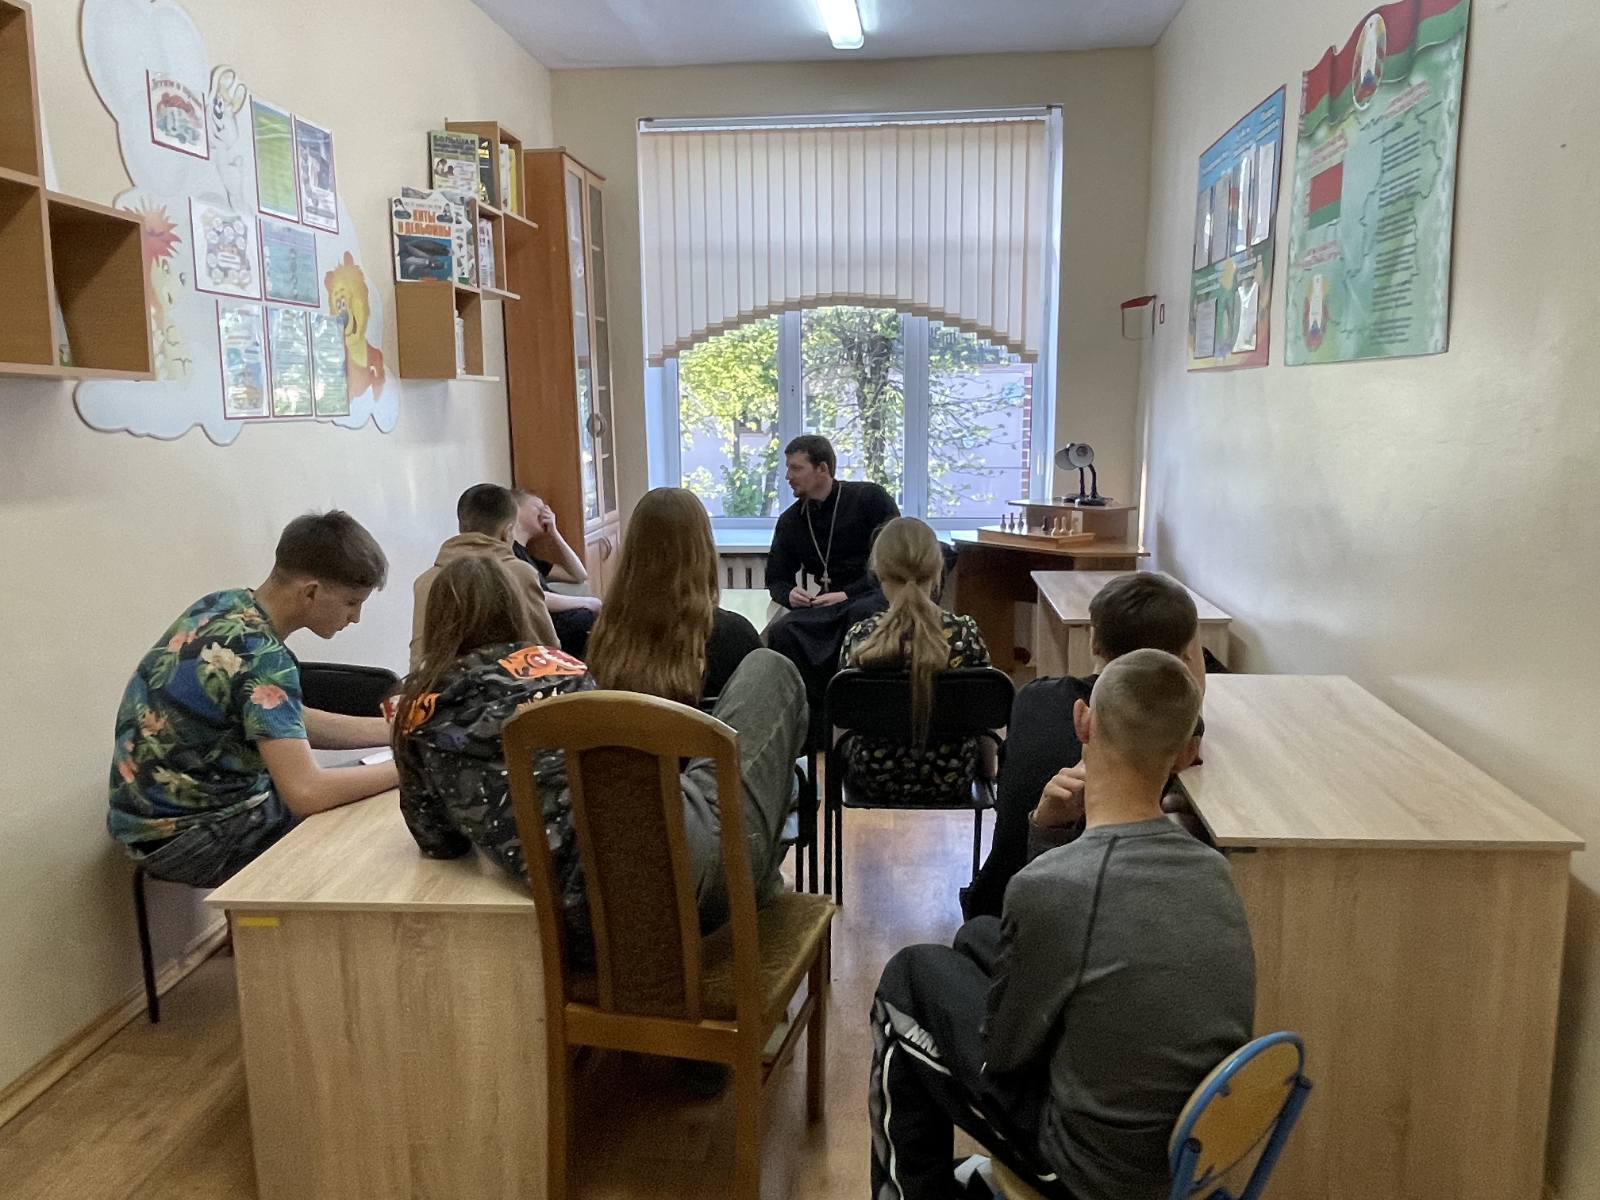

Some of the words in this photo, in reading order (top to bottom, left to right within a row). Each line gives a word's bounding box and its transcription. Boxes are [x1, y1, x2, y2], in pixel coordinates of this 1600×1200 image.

[413, 210, 436, 223] КИТЫ
[398, 222, 404, 233] И
[405, 222, 451, 238] ДЕЛЬФИНЫ
